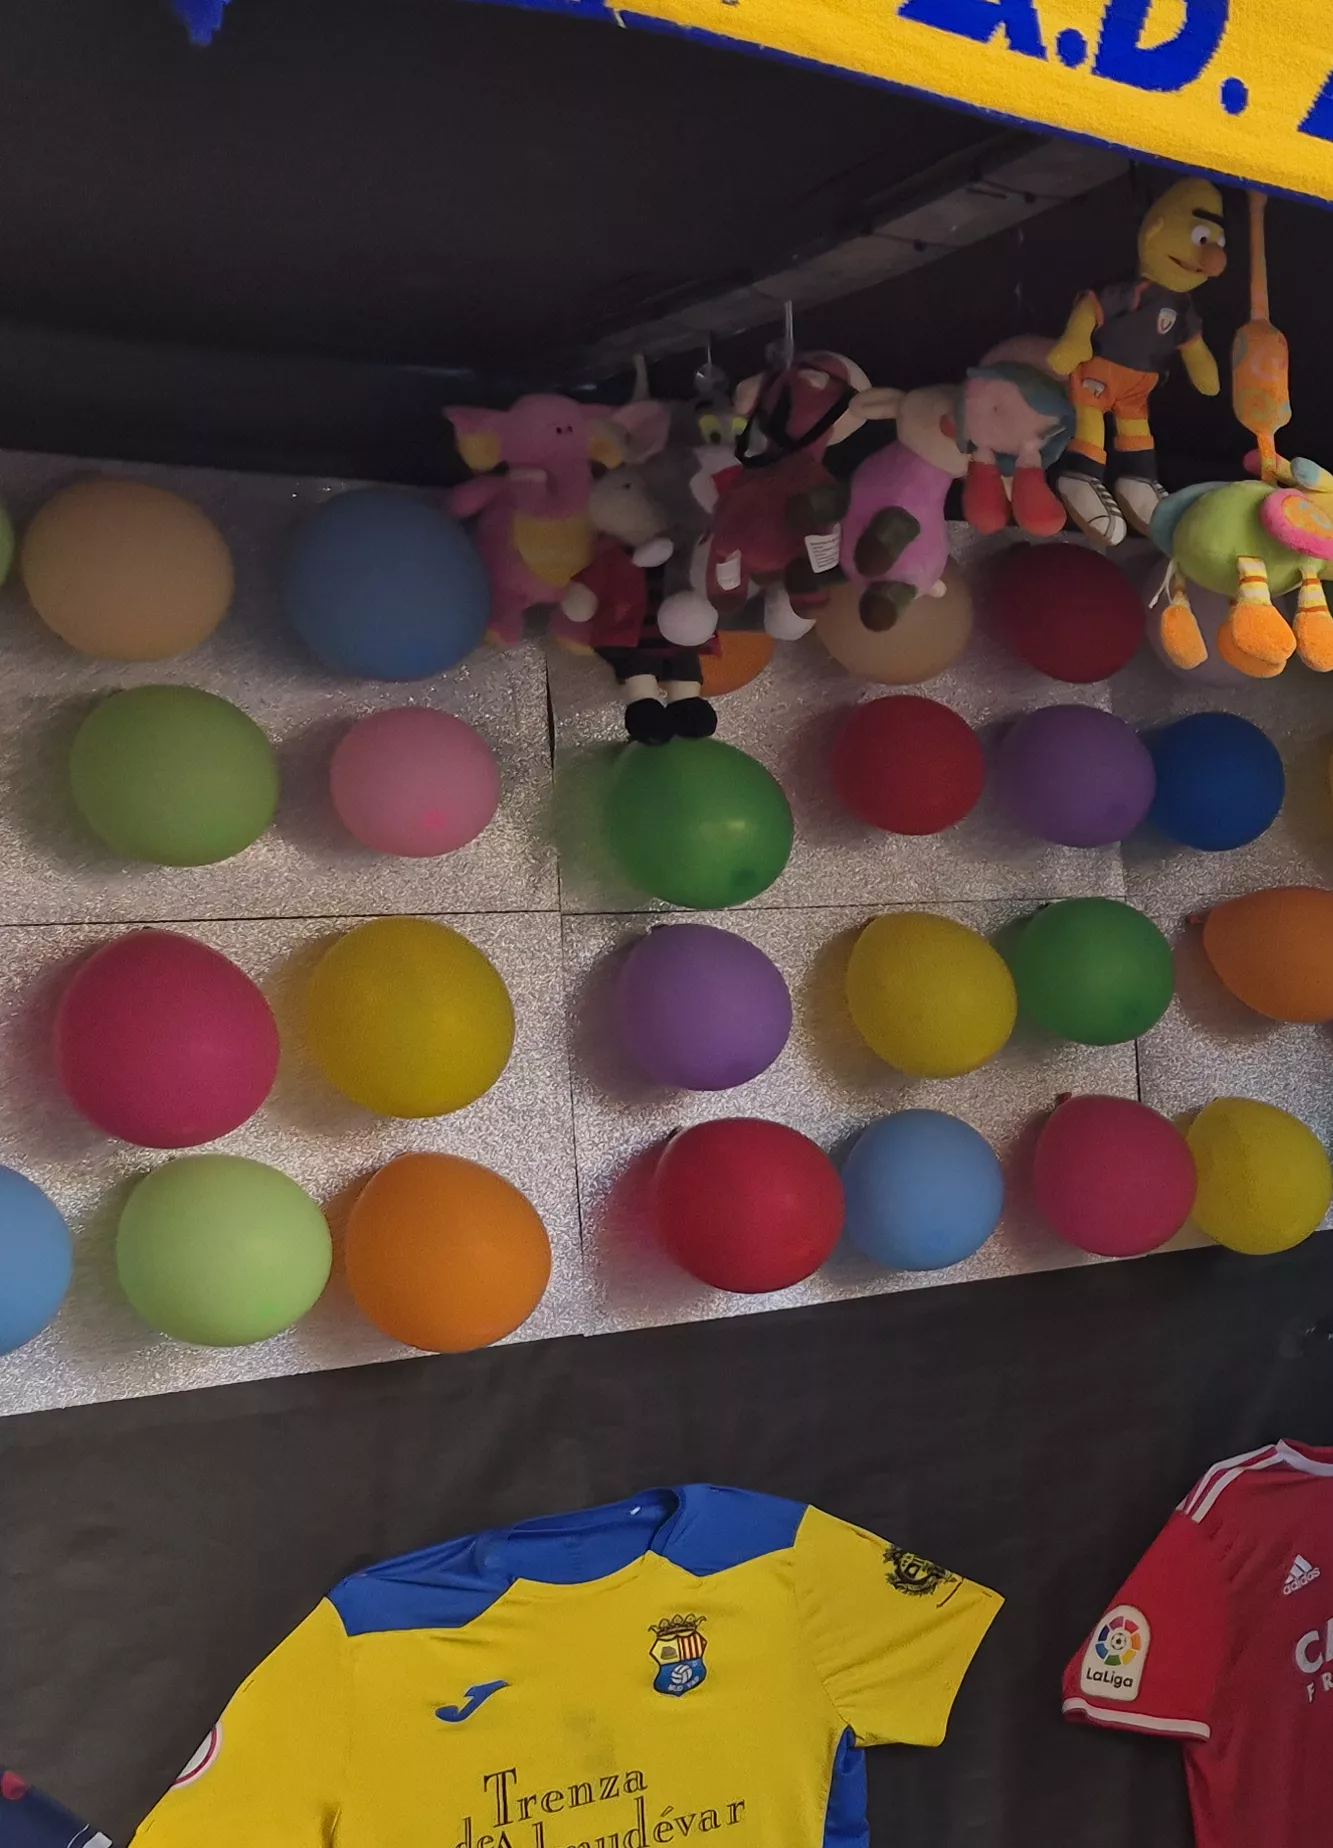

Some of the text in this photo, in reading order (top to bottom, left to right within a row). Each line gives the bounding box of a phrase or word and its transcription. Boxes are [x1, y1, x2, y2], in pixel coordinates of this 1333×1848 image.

[1282, 1566, 1321, 1596] adidas
[1085, 1667, 1134, 1689] LaLiga
[483, 1767, 648, 1829] Trenza
